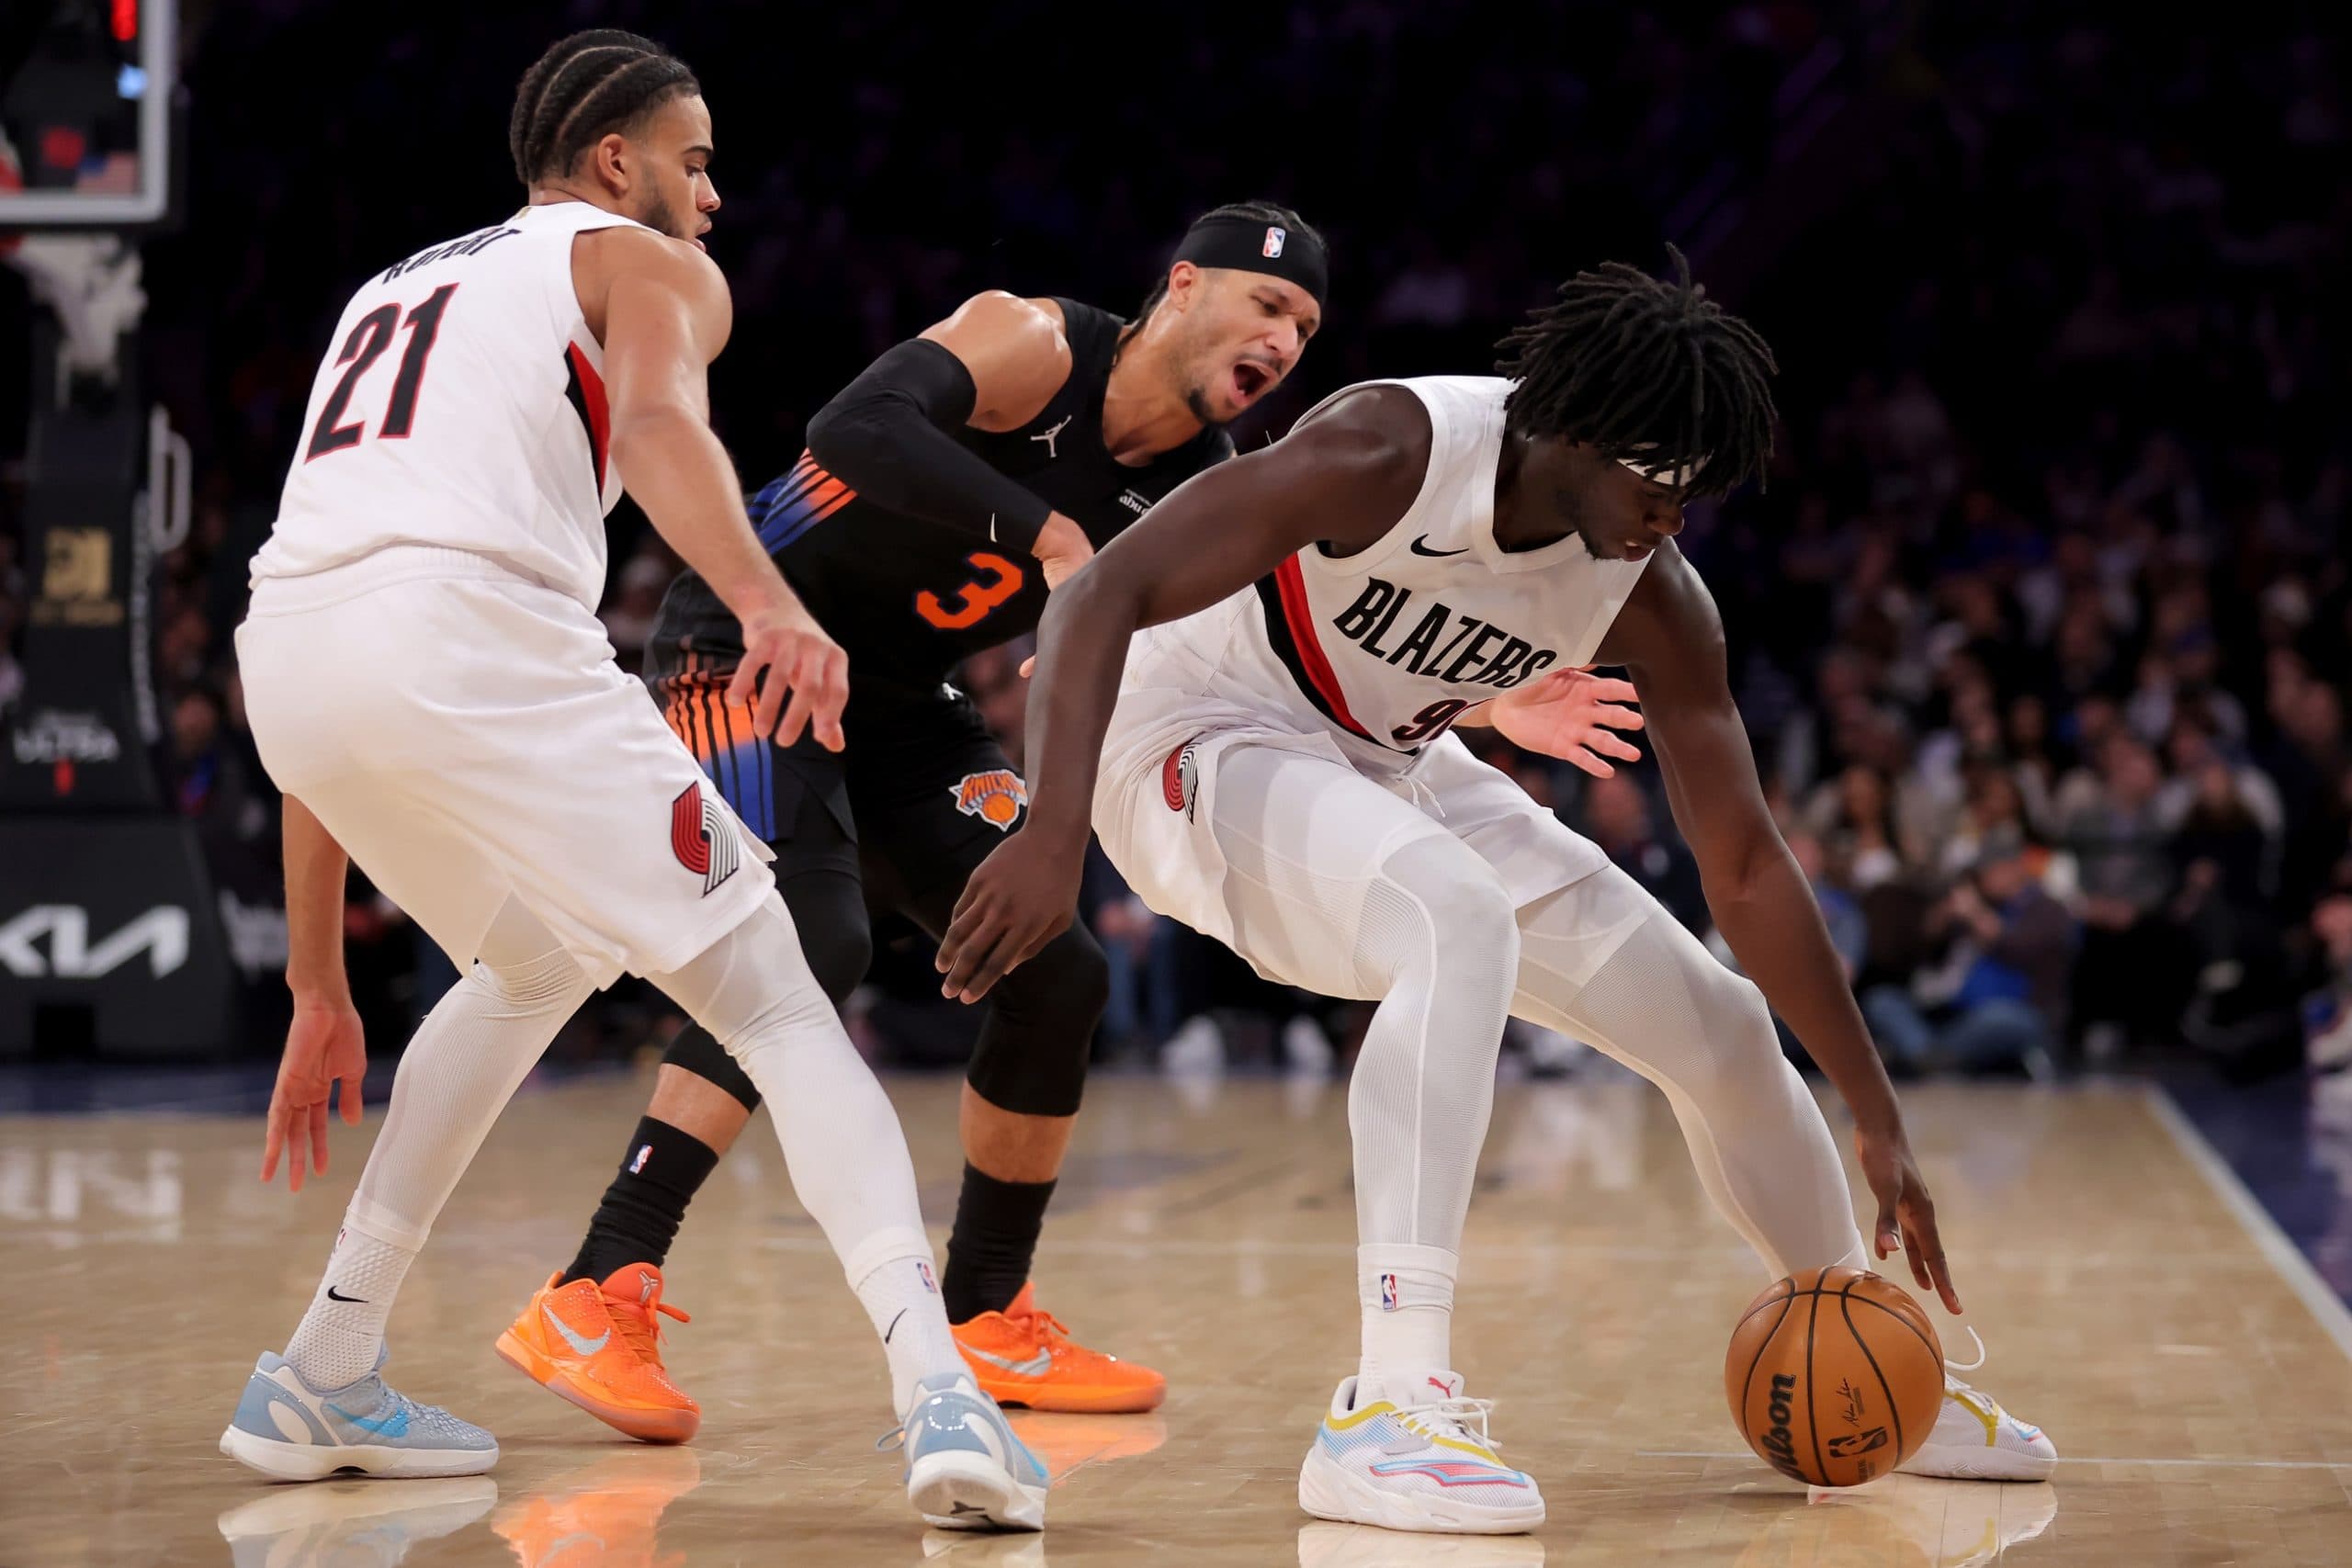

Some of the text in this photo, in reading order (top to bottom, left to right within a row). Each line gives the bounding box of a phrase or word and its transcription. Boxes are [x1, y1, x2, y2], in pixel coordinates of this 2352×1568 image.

[304, 282, 460, 464] 21
[916, 552, 1023, 629] 3
[1332, 575, 1557, 688] BLAZERS
